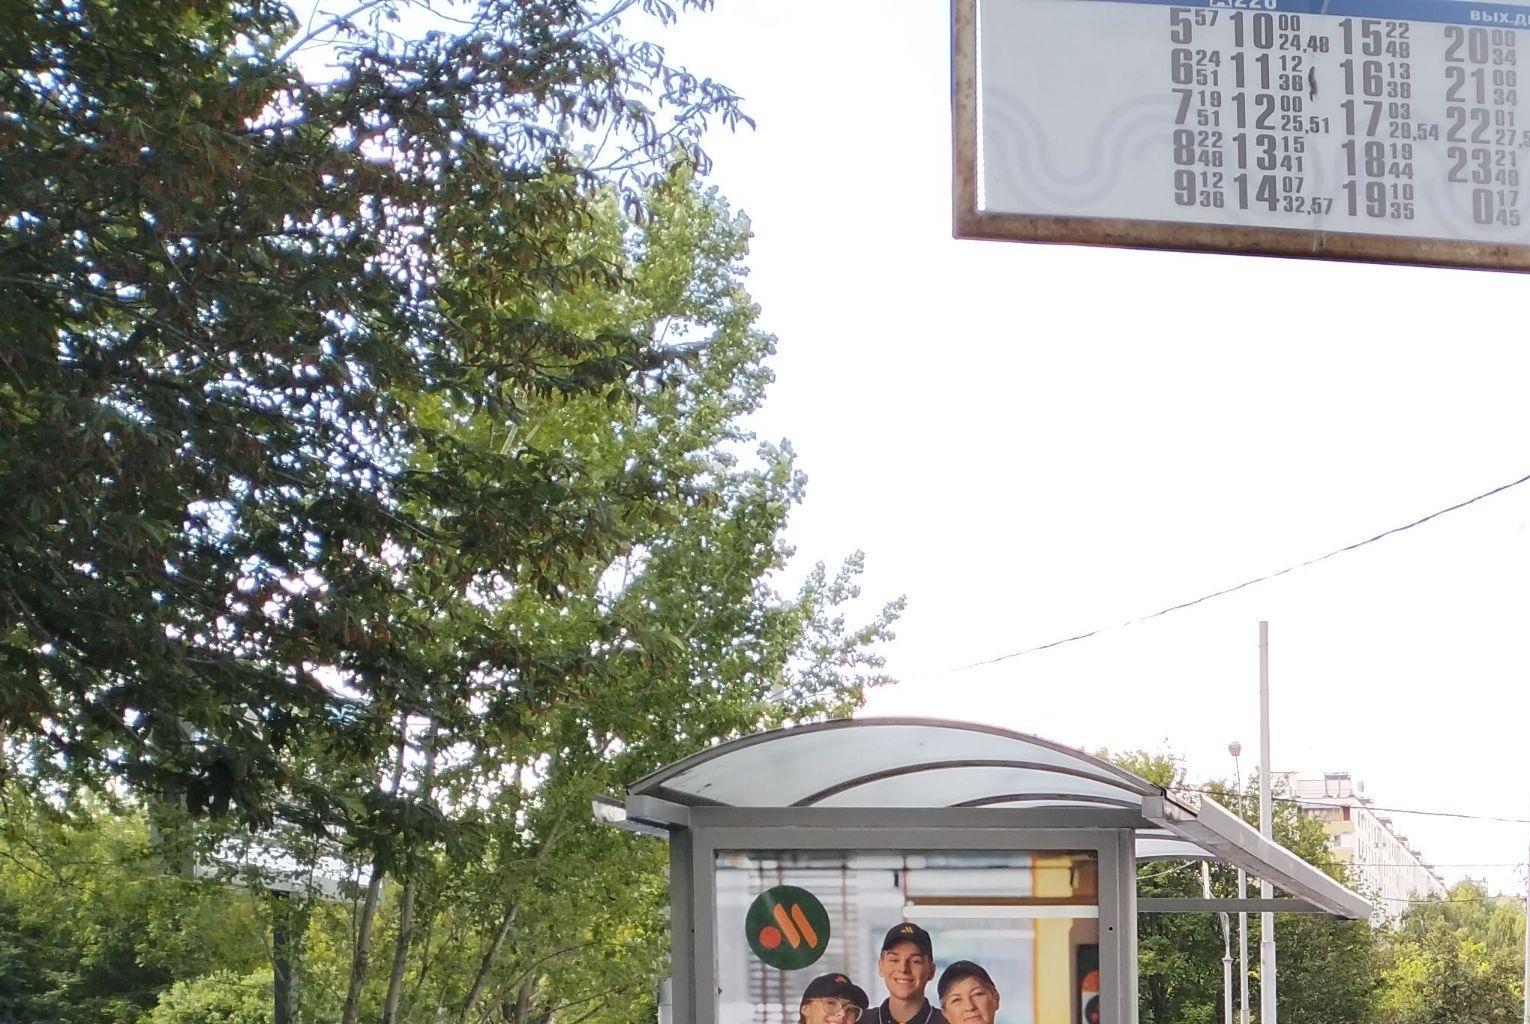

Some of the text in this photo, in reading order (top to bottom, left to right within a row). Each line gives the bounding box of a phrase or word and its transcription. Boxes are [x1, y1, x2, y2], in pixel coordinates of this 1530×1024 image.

[1170, 7, 1218, 44] 5 57
[1229, 11, 1300, 49] 10 00
[1279, 34, 1329, 53] 24,48
[1339, 18, 1409, 56] 15 22
[1385, 41, 1410, 58] 48
[1444, 26, 1488, 64] 20
[1492, 49, 1517, 66] 34
[1171, 48, 1220, 84] 6 24
[1196, 69, 1218, 86] 51
[1230, 52, 1302, 89] 11 12
[1279, 74, 1303, 91] 36
[1340, 59, 1410, 97] 16 13
[1445, 66, 1485, 104] 21
[1494, 89, 1517, 106] 34
[1172, 88, 1221, 124] 7 19
[1197, 109, 1219, 127] 51
[1232, 92, 1302, 130] 12 00
[1341, 99, 1410, 137] 17 03
[1281, 115, 1329, 134] 25,51
[1446, 106, 1514, 144] 22 01
[1173, 129, 1223, 165] 8 22
[1198, 150, 1223, 167] 48
[1232, 133, 1304, 170] 13 15
[1280, 155, 1303, 172] 41
[1341, 140, 1412, 177] 18 19
[1447, 146, 1516, 184] 23 21
[1174, 170, 1223, 206] 9 12
[1388, 162, 1414, 179] 44
[1199, 191, 1224, 208] 36
[1233, 173, 1304, 211] 14 07
[1283, 196, 1333, 215] 32,57
[1342, 180, 1413, 217] 19 10
[1472, 188, 1519, 224] 0 17
[1390, 202, 1414, 219] 35
[1495, 209, 1520, 226] 45
